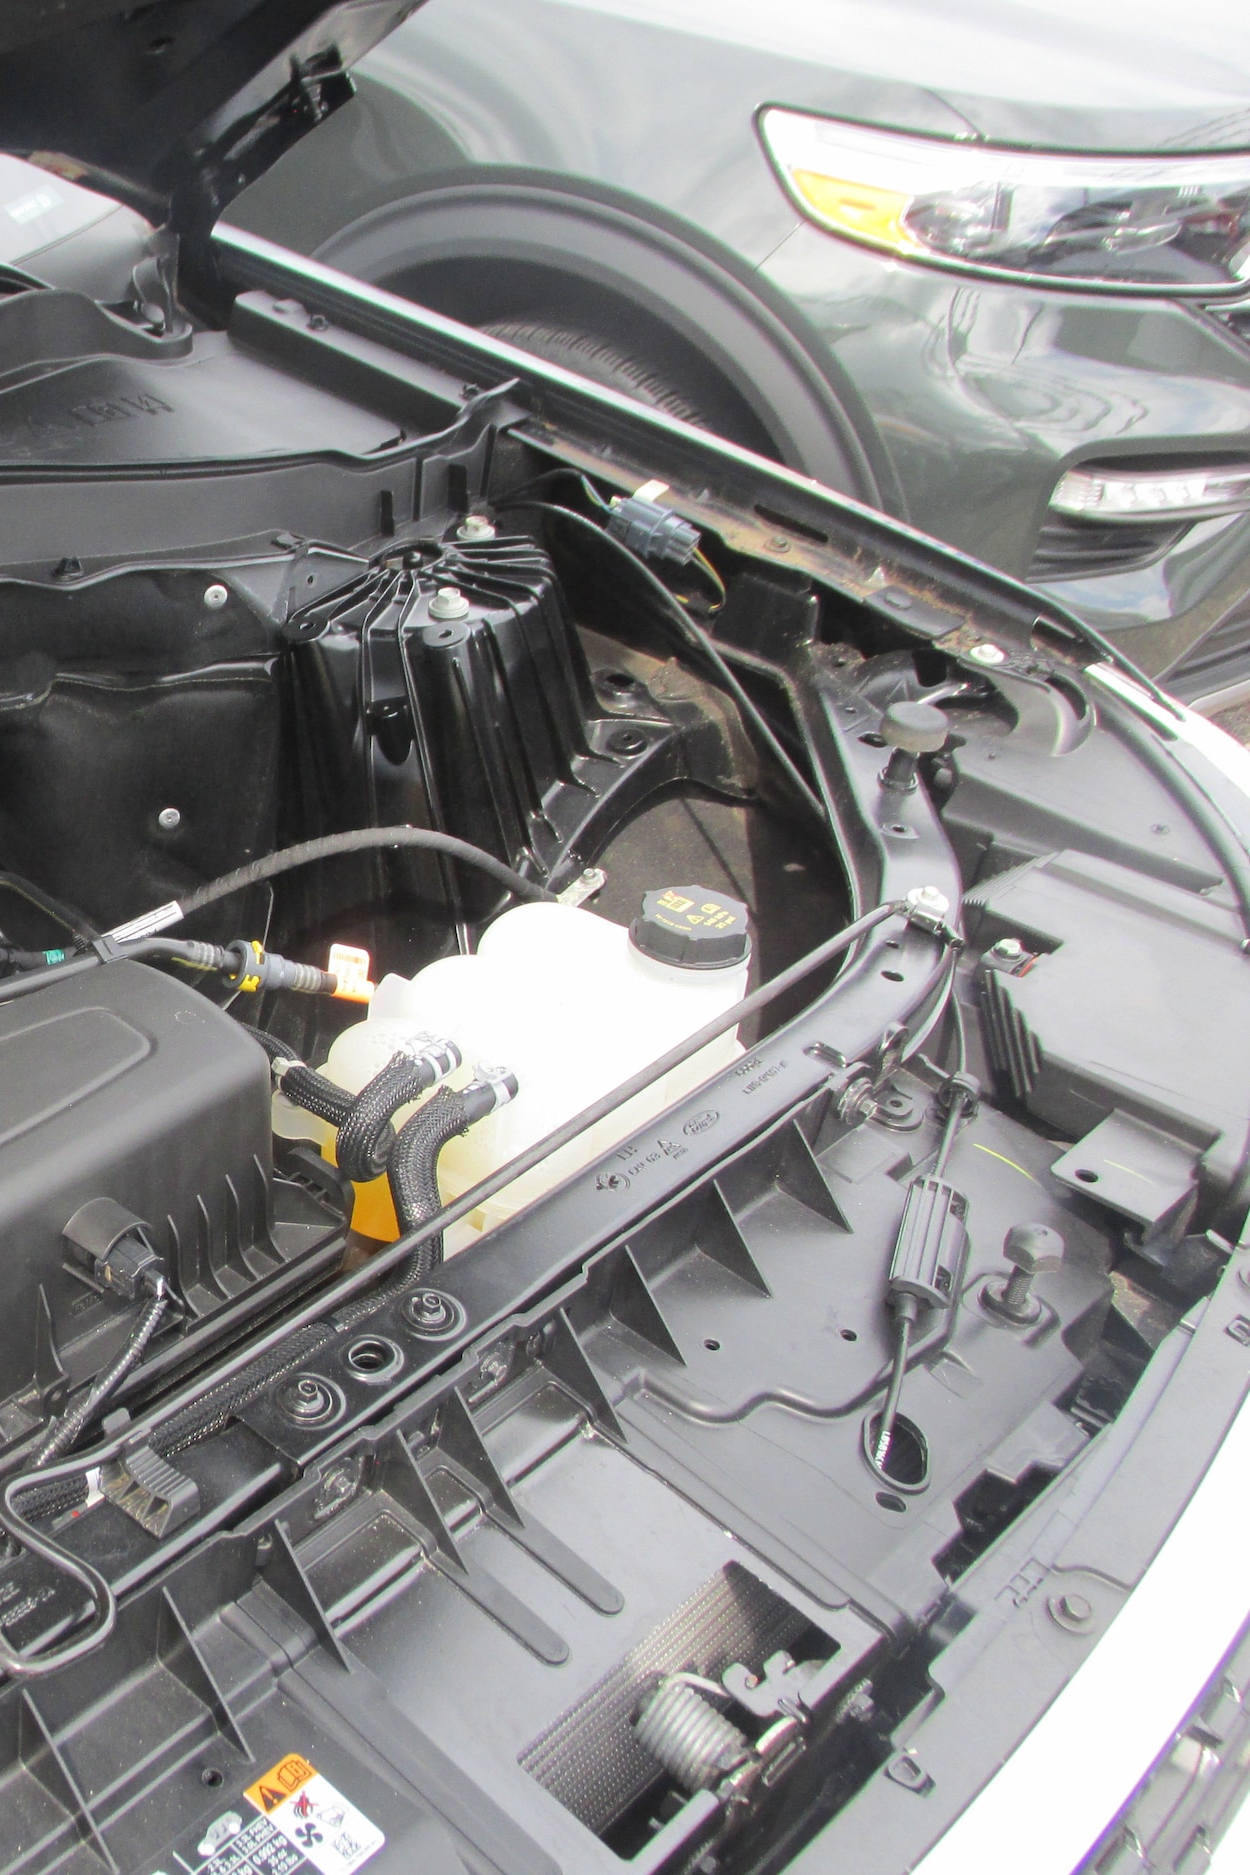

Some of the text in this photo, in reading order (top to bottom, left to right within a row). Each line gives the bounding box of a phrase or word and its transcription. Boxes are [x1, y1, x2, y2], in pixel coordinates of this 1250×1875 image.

[687, 1112, 716, 1133] Ford
[272, 1835, 287, 1848] kg
[277, 1848, 288, 1860] oz
